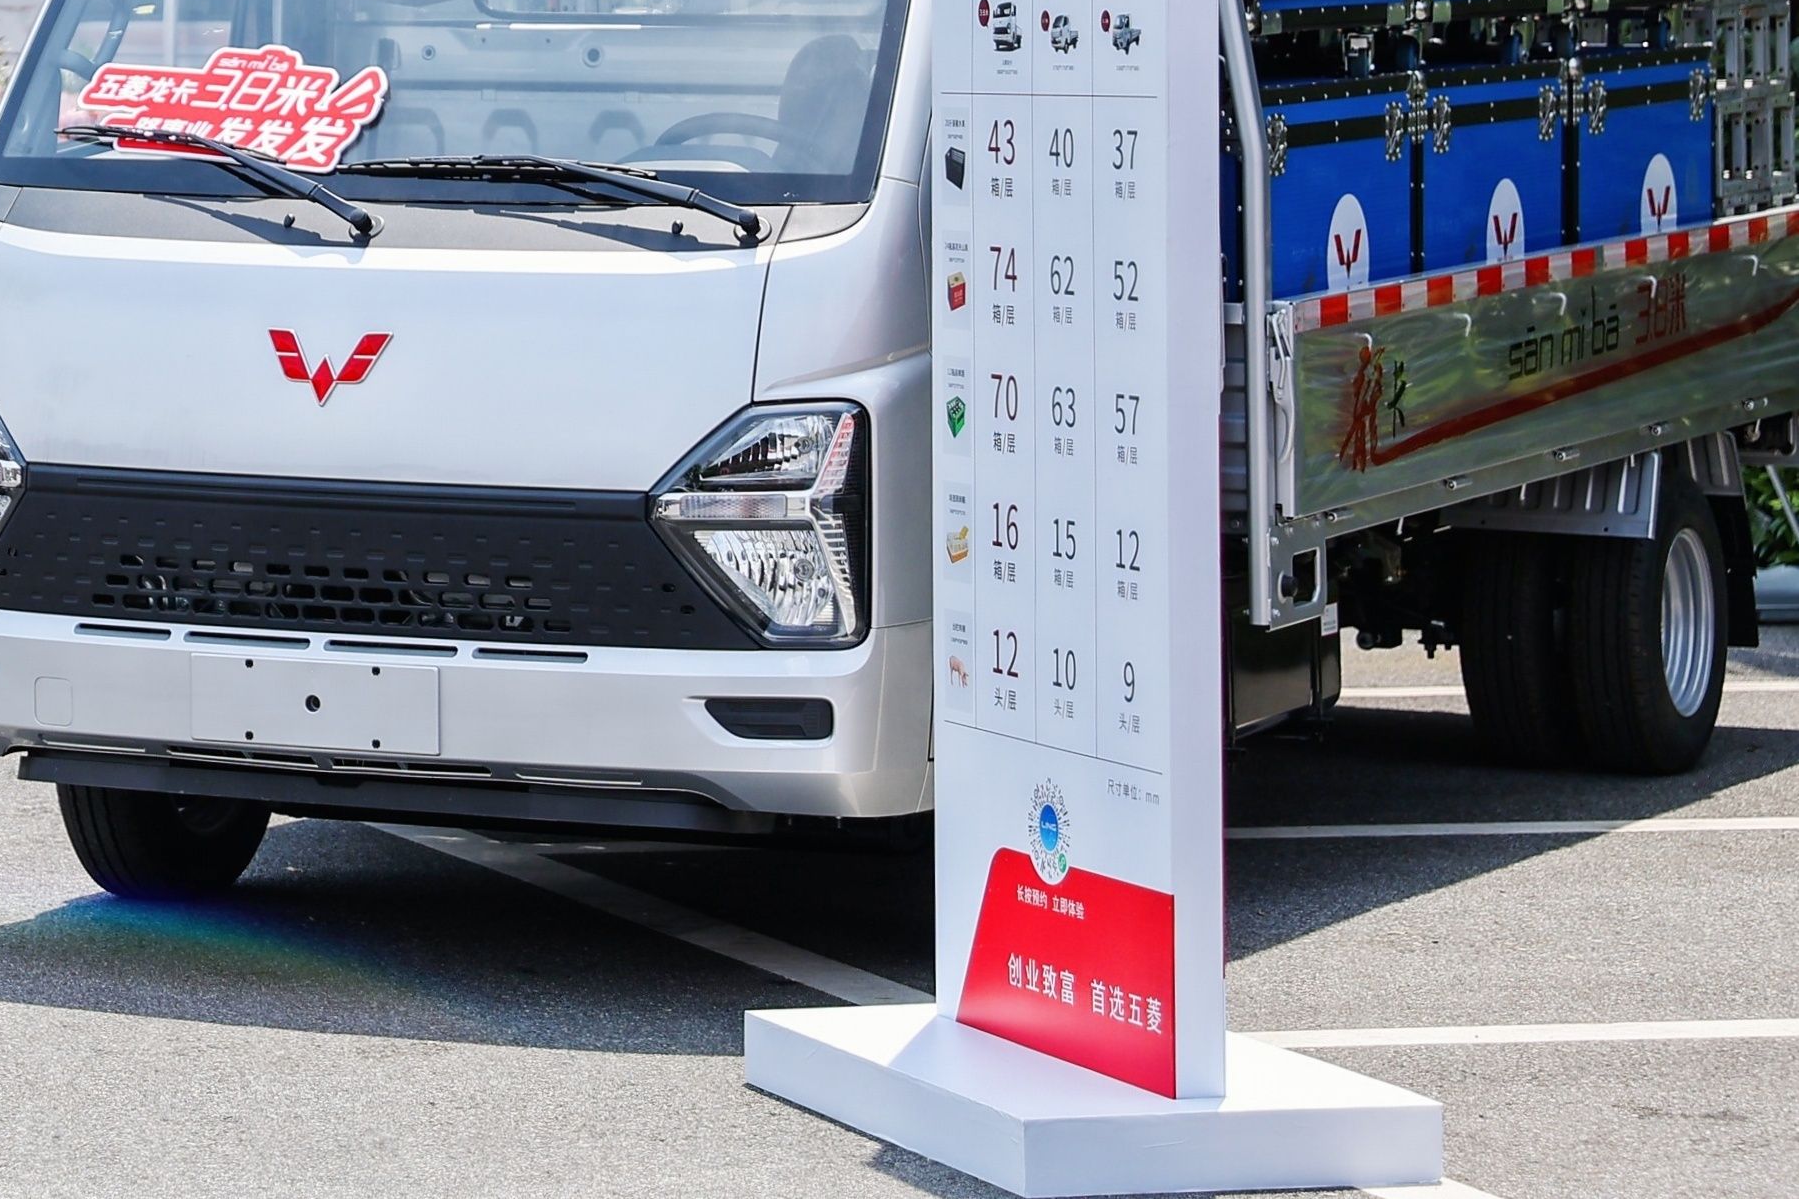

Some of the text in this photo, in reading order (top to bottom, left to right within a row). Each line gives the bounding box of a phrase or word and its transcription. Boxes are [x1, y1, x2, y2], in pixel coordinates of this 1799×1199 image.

[987, 119, 1016, 166] 43
[1048, 128, 1074, 168] 40
[1112, 129, 1138, 170] 37
[989, 246, 1018, 293] 74
[1050, 255, 1075, 296] 62
[1112, 260, 1139, 302] 52
[990, 373, 1019, 422] 70
[1051, 386, 1076, 428] 63
[1114, 393, 1140, 436] 57
[991, 502, 1019, 550] 16
[1052, 518, 1076, 560] 15
[1115, 528, 1141, 572] 12
[992, 629, 1019, 678] 12
[1052, 647, 1077, 691] 10
[1123, 661, 1136, 703] 9
[1016, 883, 1085, 920] 长按预约 立即体验
[1007, 952, 1163, 1035] 创业致富 首选五菱
